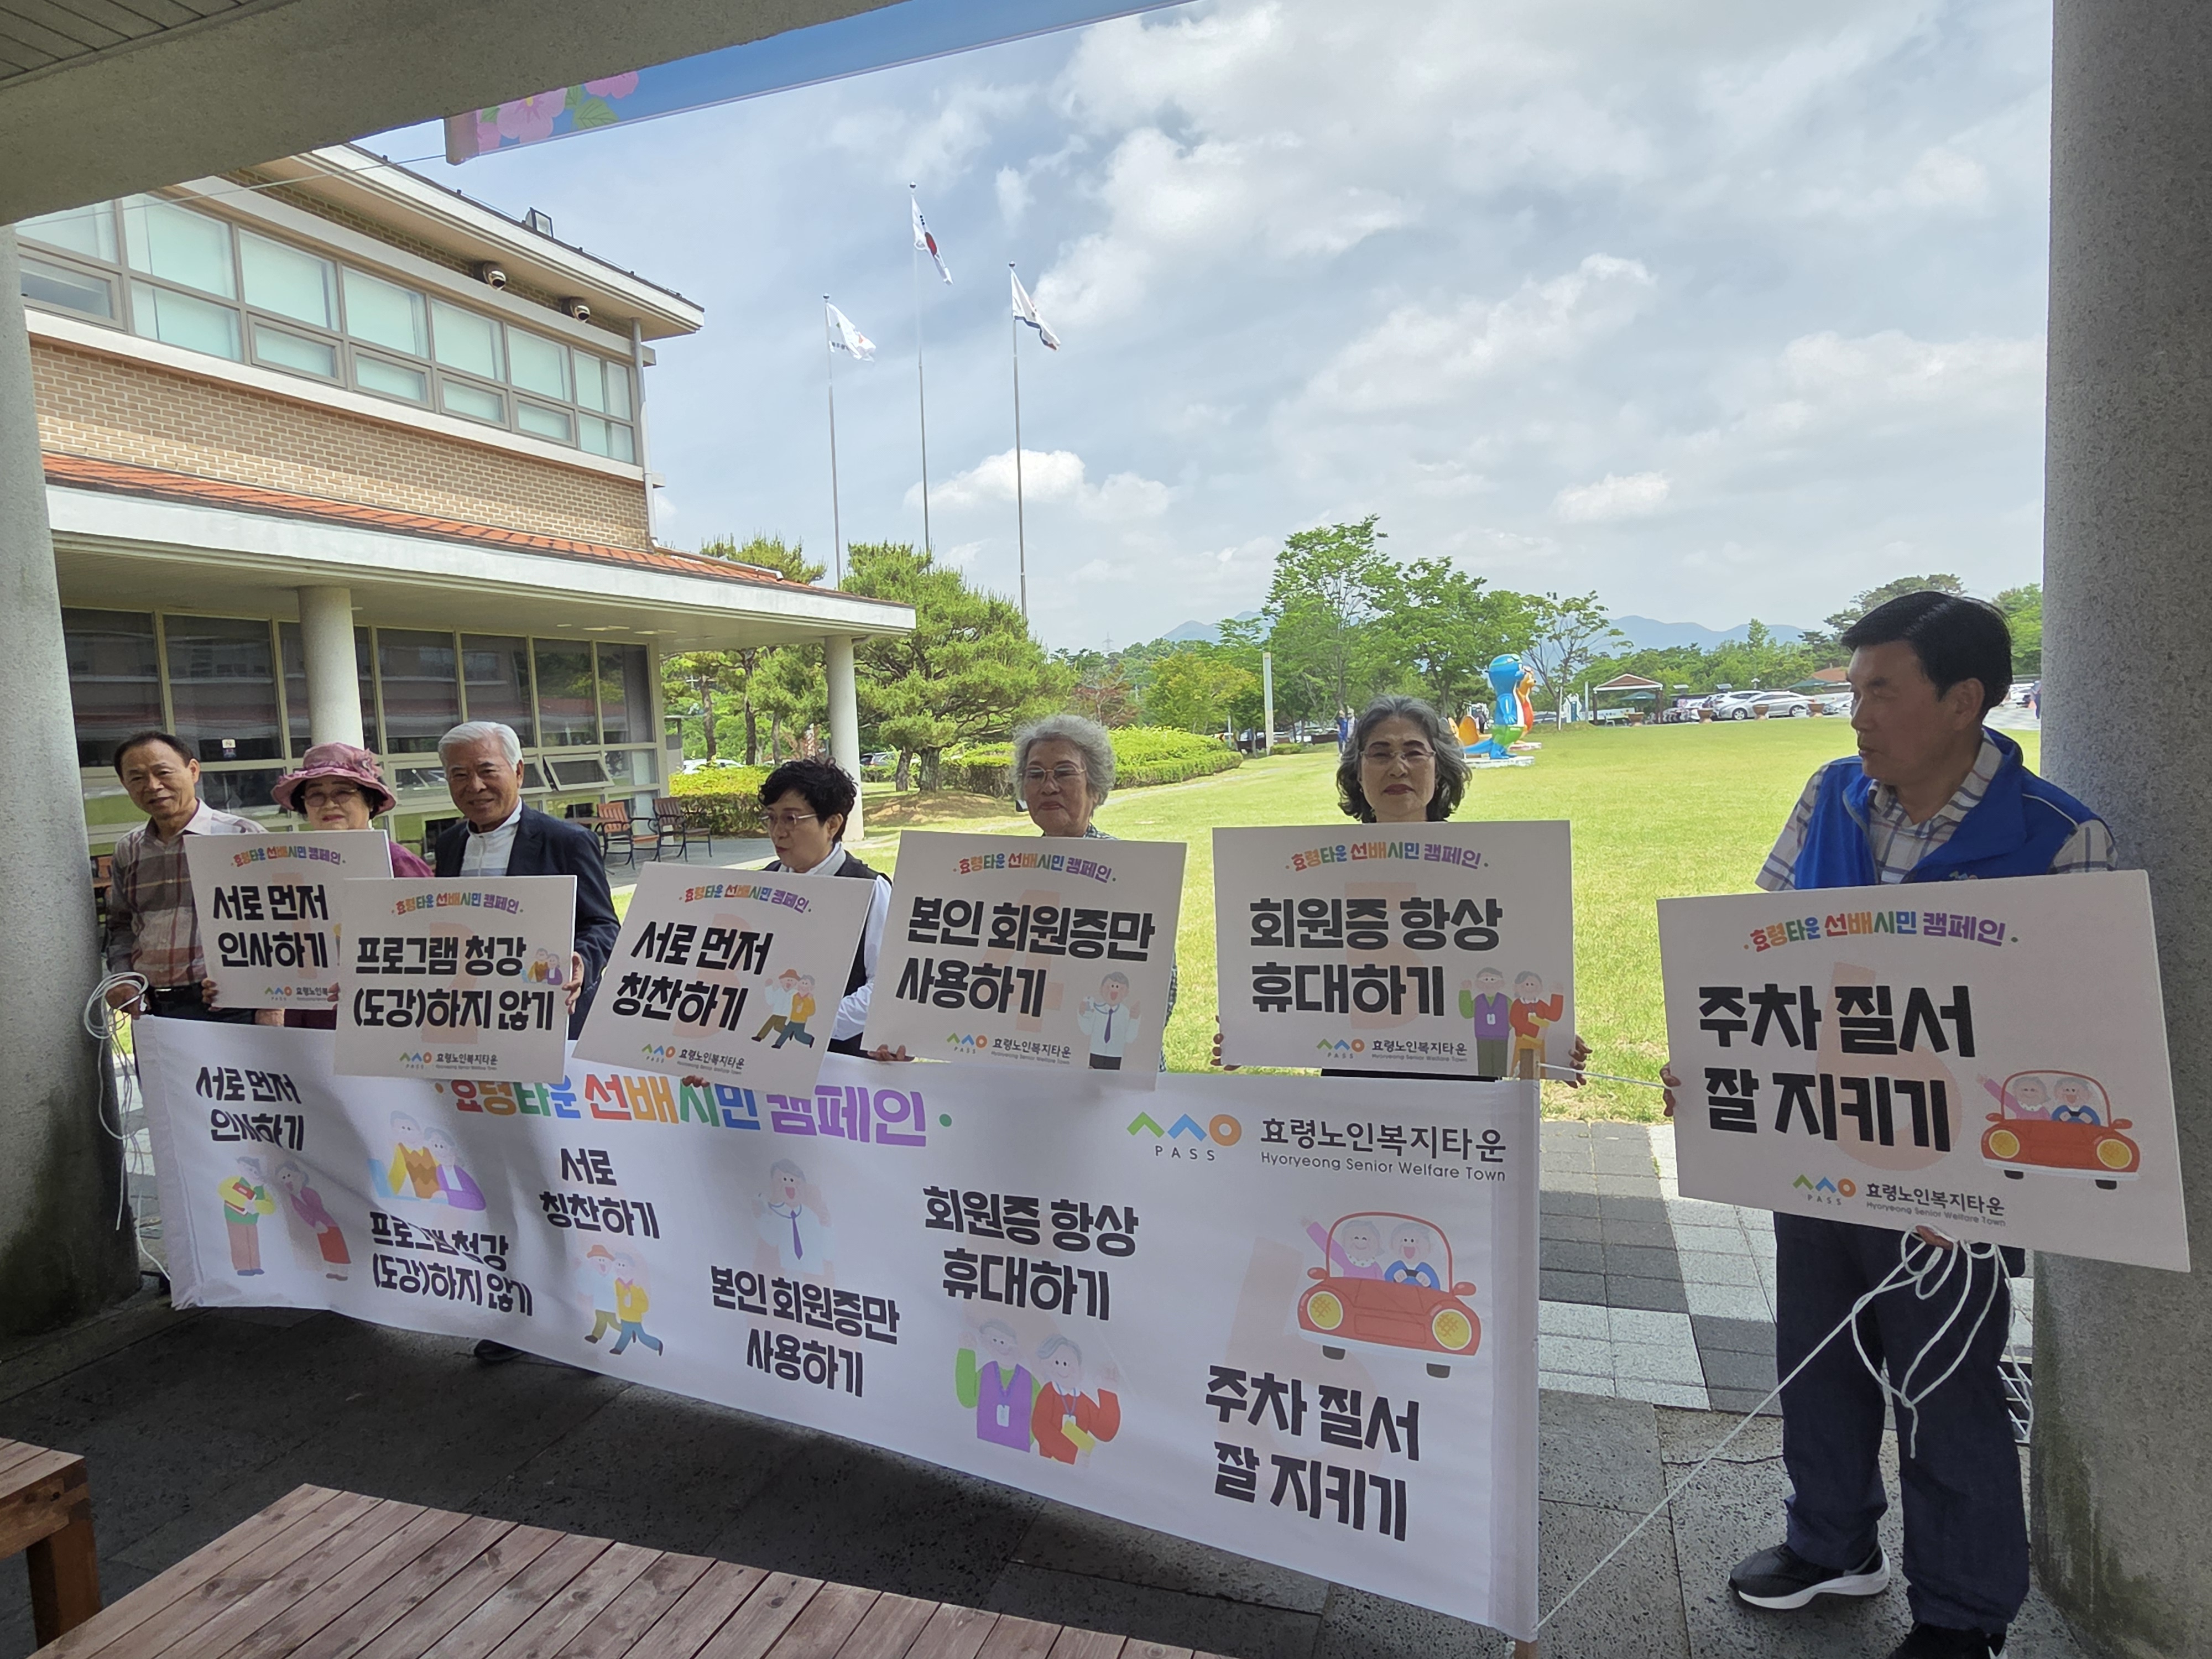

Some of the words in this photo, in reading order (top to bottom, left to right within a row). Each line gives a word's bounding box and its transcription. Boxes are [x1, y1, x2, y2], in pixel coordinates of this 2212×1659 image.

[958, 853, 1005, 875] 효령타운
[1008, 852, 1065, 872] 선배시민
[1065, 856, 1113, 884] 캠페인
[1291, 844, 1347, 872] 효령타운
[1350, 842, 1420, 861] 선배시민
[1423, 843, 1481, 869] 캠페인
[213, 886, 264, 920] 서로
[268, 885, 328, 920] 먼저
[685, 885, 723, 903] 효령타운
[724, 884, 771, 901] 선배시민
[771, 889, 810, 913] 캠페인
[907, 896, 984, 948] 본인
[988, 901, 1156, 962] 회원증만
[1249, 898, 1389, 951] 회원증
[1399, 897, 1503, 951] 항상
[1750, 916, 1820, 953] 효령타운
[1824, 910, 1917, 937] 선배시민
[1922, 912, 2007, 947] 캠페인
[218, 932, 328, 968] 인사하기
[356, 936, 458, 976] 프로그램
[465, 937, 526, 976] 청강
[630, 921, 697, 966] 서로
[696, 925, 774, 975] 먼저
[612, 972, 748, 1031] 칭찬하기
[895, 957, 1047, 1018] 사용하기
[1251, 961, 1444, 1017] 휴대하기
[353, 989, 490, 1030] (도강)하지
[499, 991, 554, 1031] 않기
[1698, 983, 1822, 1051] 주차
[1834, 984, 1976, 1058] 질서
[993, 1038, 1072, 1059] 효령노인복지타운
[1372, 1040, 1467, 1056] 효령노인복지타운
[196, 1066, 246, 1101] 서로
[245, 1069, 302, 1104] 먼저
[585, 1074, 761, 1130] 선배시민
[211, 1108, 304, 1151] 인사하기
[1704, 1067, 1760, 1134] 잘
[1772, 1072, 1952, 1152] 지키기
[1155, 1145, 1215, 1162] PASS
[1260, 1118, 1506, 1164] 효령노인복지타운
[560, 1148, 617, 1186] 서로
[1261, 1151, 1341, 1171] Hyoryeong
[1346, 1157, 1393, 1173] Senior
[1398, 1161, 1459, 1179] Welfare
[1465, 1166, 1505, 1182] Town
[539, 1191, 660, 1239] 칭찬하기
[923, 1186, 1041, 1245] 회원증
[1050, 1198, 1139, 1257] 항상
[1807, 1194, 1841, 1206] PASS
[1866, 1183, 2005, 1216] 효령노인복지타운
[1914, 1207, 1942, 1217] Senior
[1944, 1211, 1979, 1224] Welfare
[1983, 1216, 2006, 1227] Town
[373, 1253, 482, 1306] (도강)하지
[487, 1273, 533, 1317] 않기
[711, 1265, 768, 1316] 본인
[771, 1276, 900, 1346] 회원증만
[942, 1248, 1109, 1321] 휴대하기
[747, 1329, 863, 1398] 사용하기
[1206, 1365, 1307, 1437] 주차
[1318, 1384, 1420, 1462] 질서
[1214, 1441, 1260, 1504] 잘
[1270, 1453, 1406, 1543] 지키기
